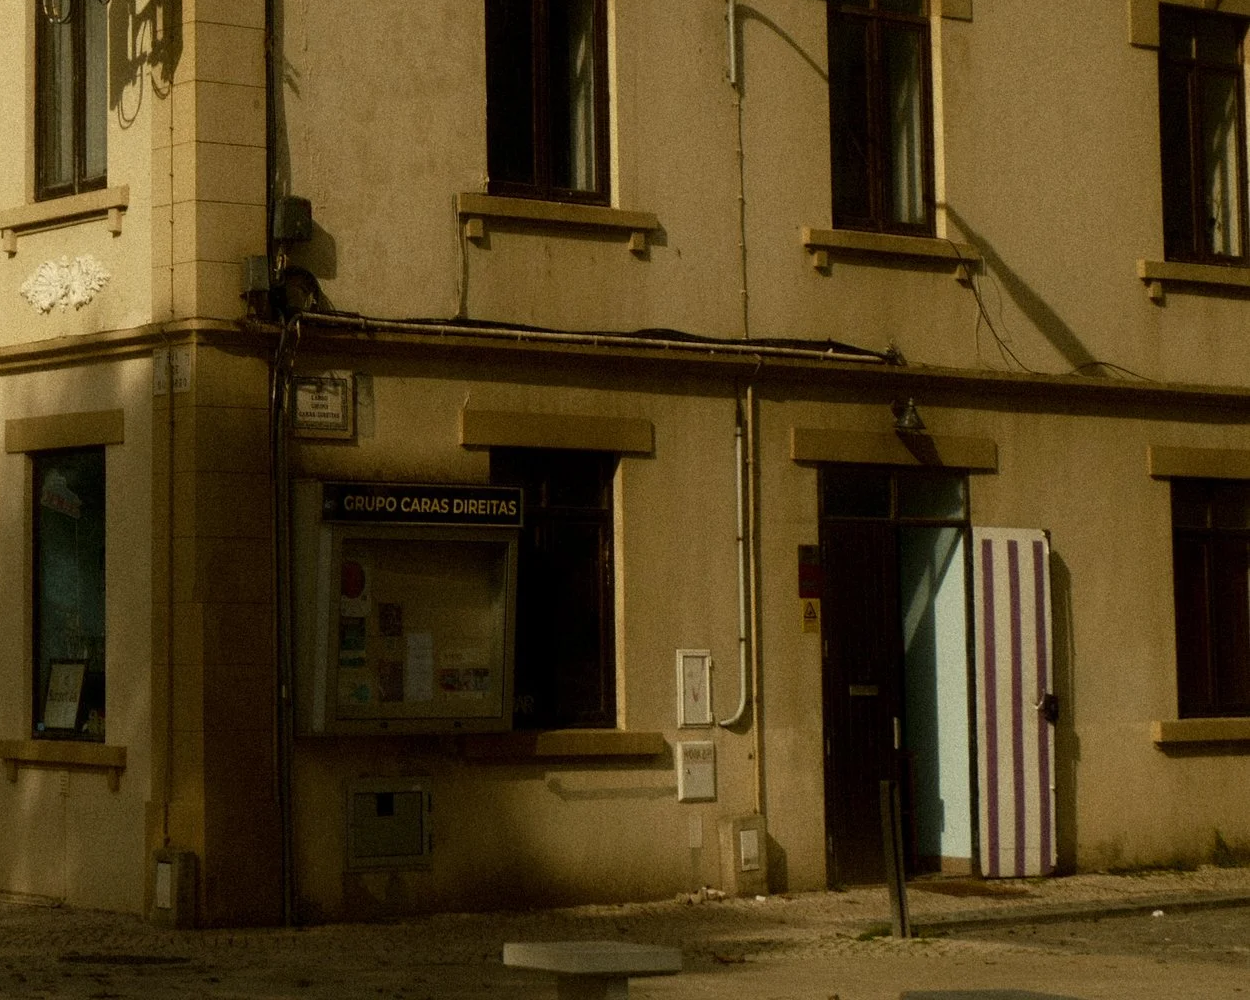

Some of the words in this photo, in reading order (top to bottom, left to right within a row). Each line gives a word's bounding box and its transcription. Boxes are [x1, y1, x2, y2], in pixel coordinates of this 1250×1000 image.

[343, 494, 397, 512] GRUPO
[400, 496, 449, 514] CARAS
[452, 497, 517, 517] DIREITAS
